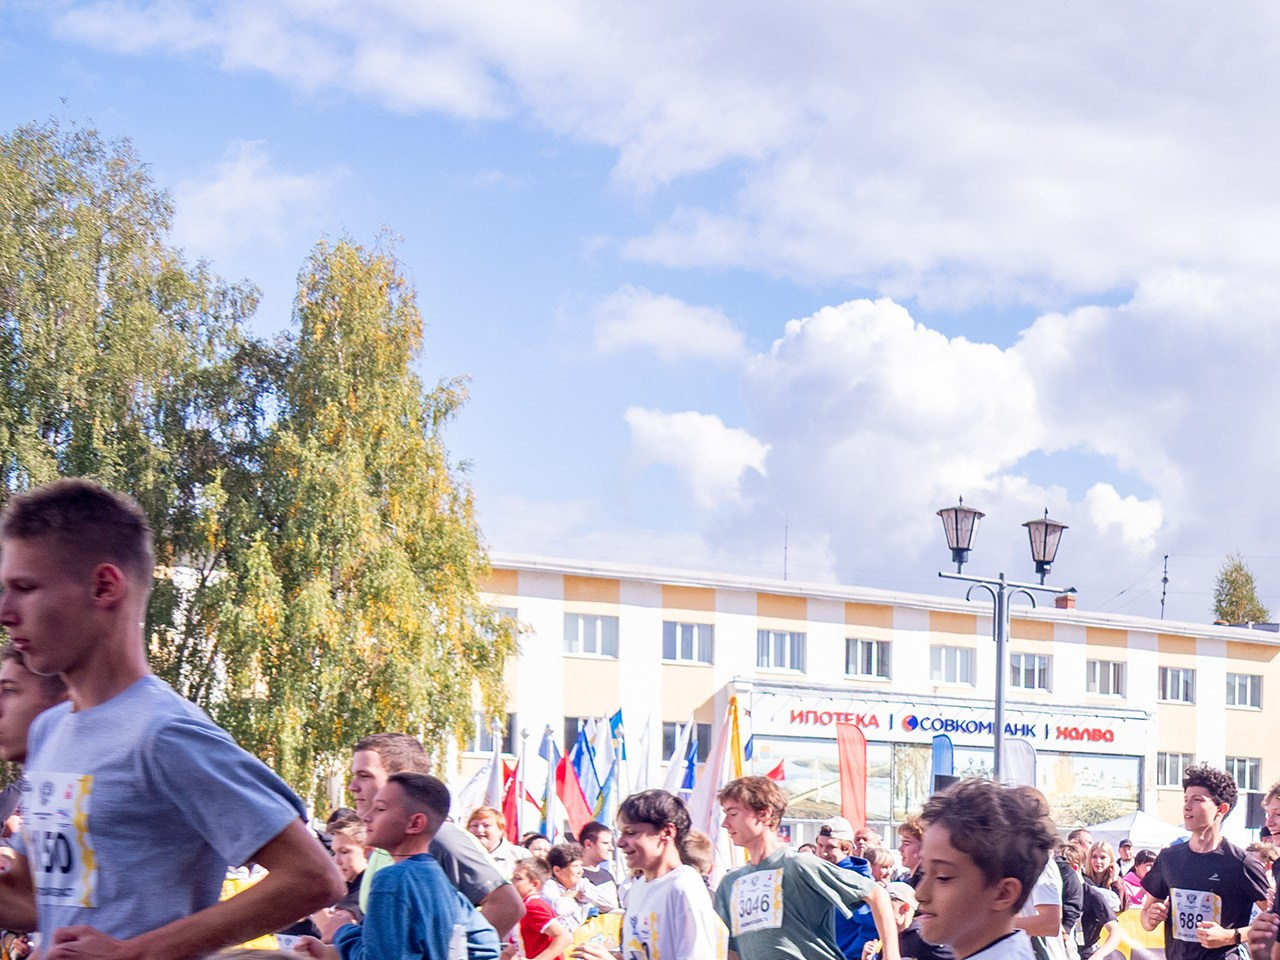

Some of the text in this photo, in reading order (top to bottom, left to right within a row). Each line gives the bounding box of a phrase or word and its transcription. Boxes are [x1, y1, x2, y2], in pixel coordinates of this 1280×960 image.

[789, 709, 880, 728] ИПОТЕКА
[920, 717, 1037, 738] СОВКОМАНК
[739, 894, 770, 918] 3046
